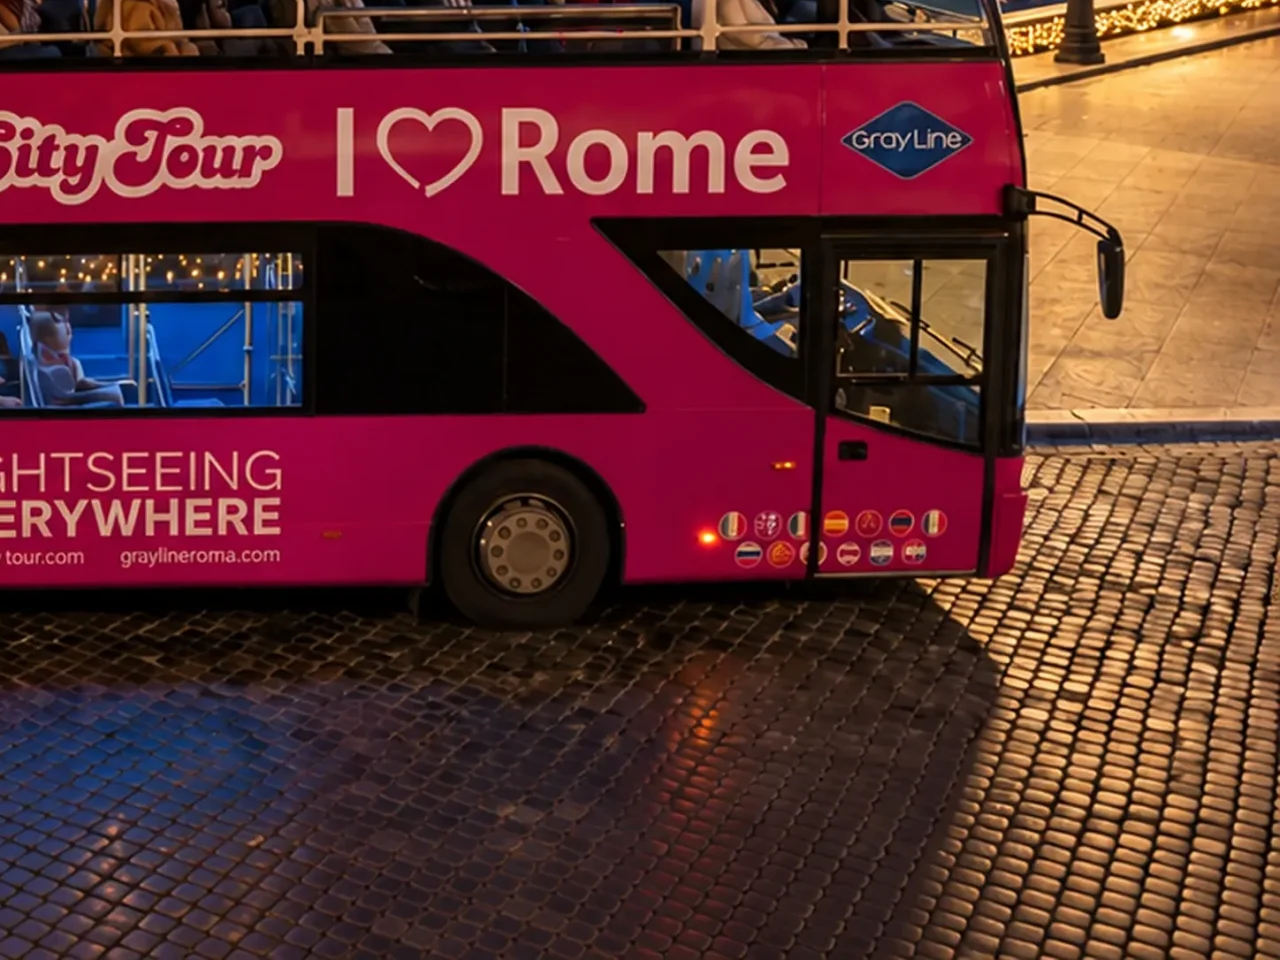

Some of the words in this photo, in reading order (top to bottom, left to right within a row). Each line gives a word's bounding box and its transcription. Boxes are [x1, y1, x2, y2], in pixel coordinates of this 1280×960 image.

[111, 107, 283, 198] Tour
[336, 107, 354, 197] I
[501, 107, 790, 196] Rome
[120, 546, 280, 569] graylineroma.com
